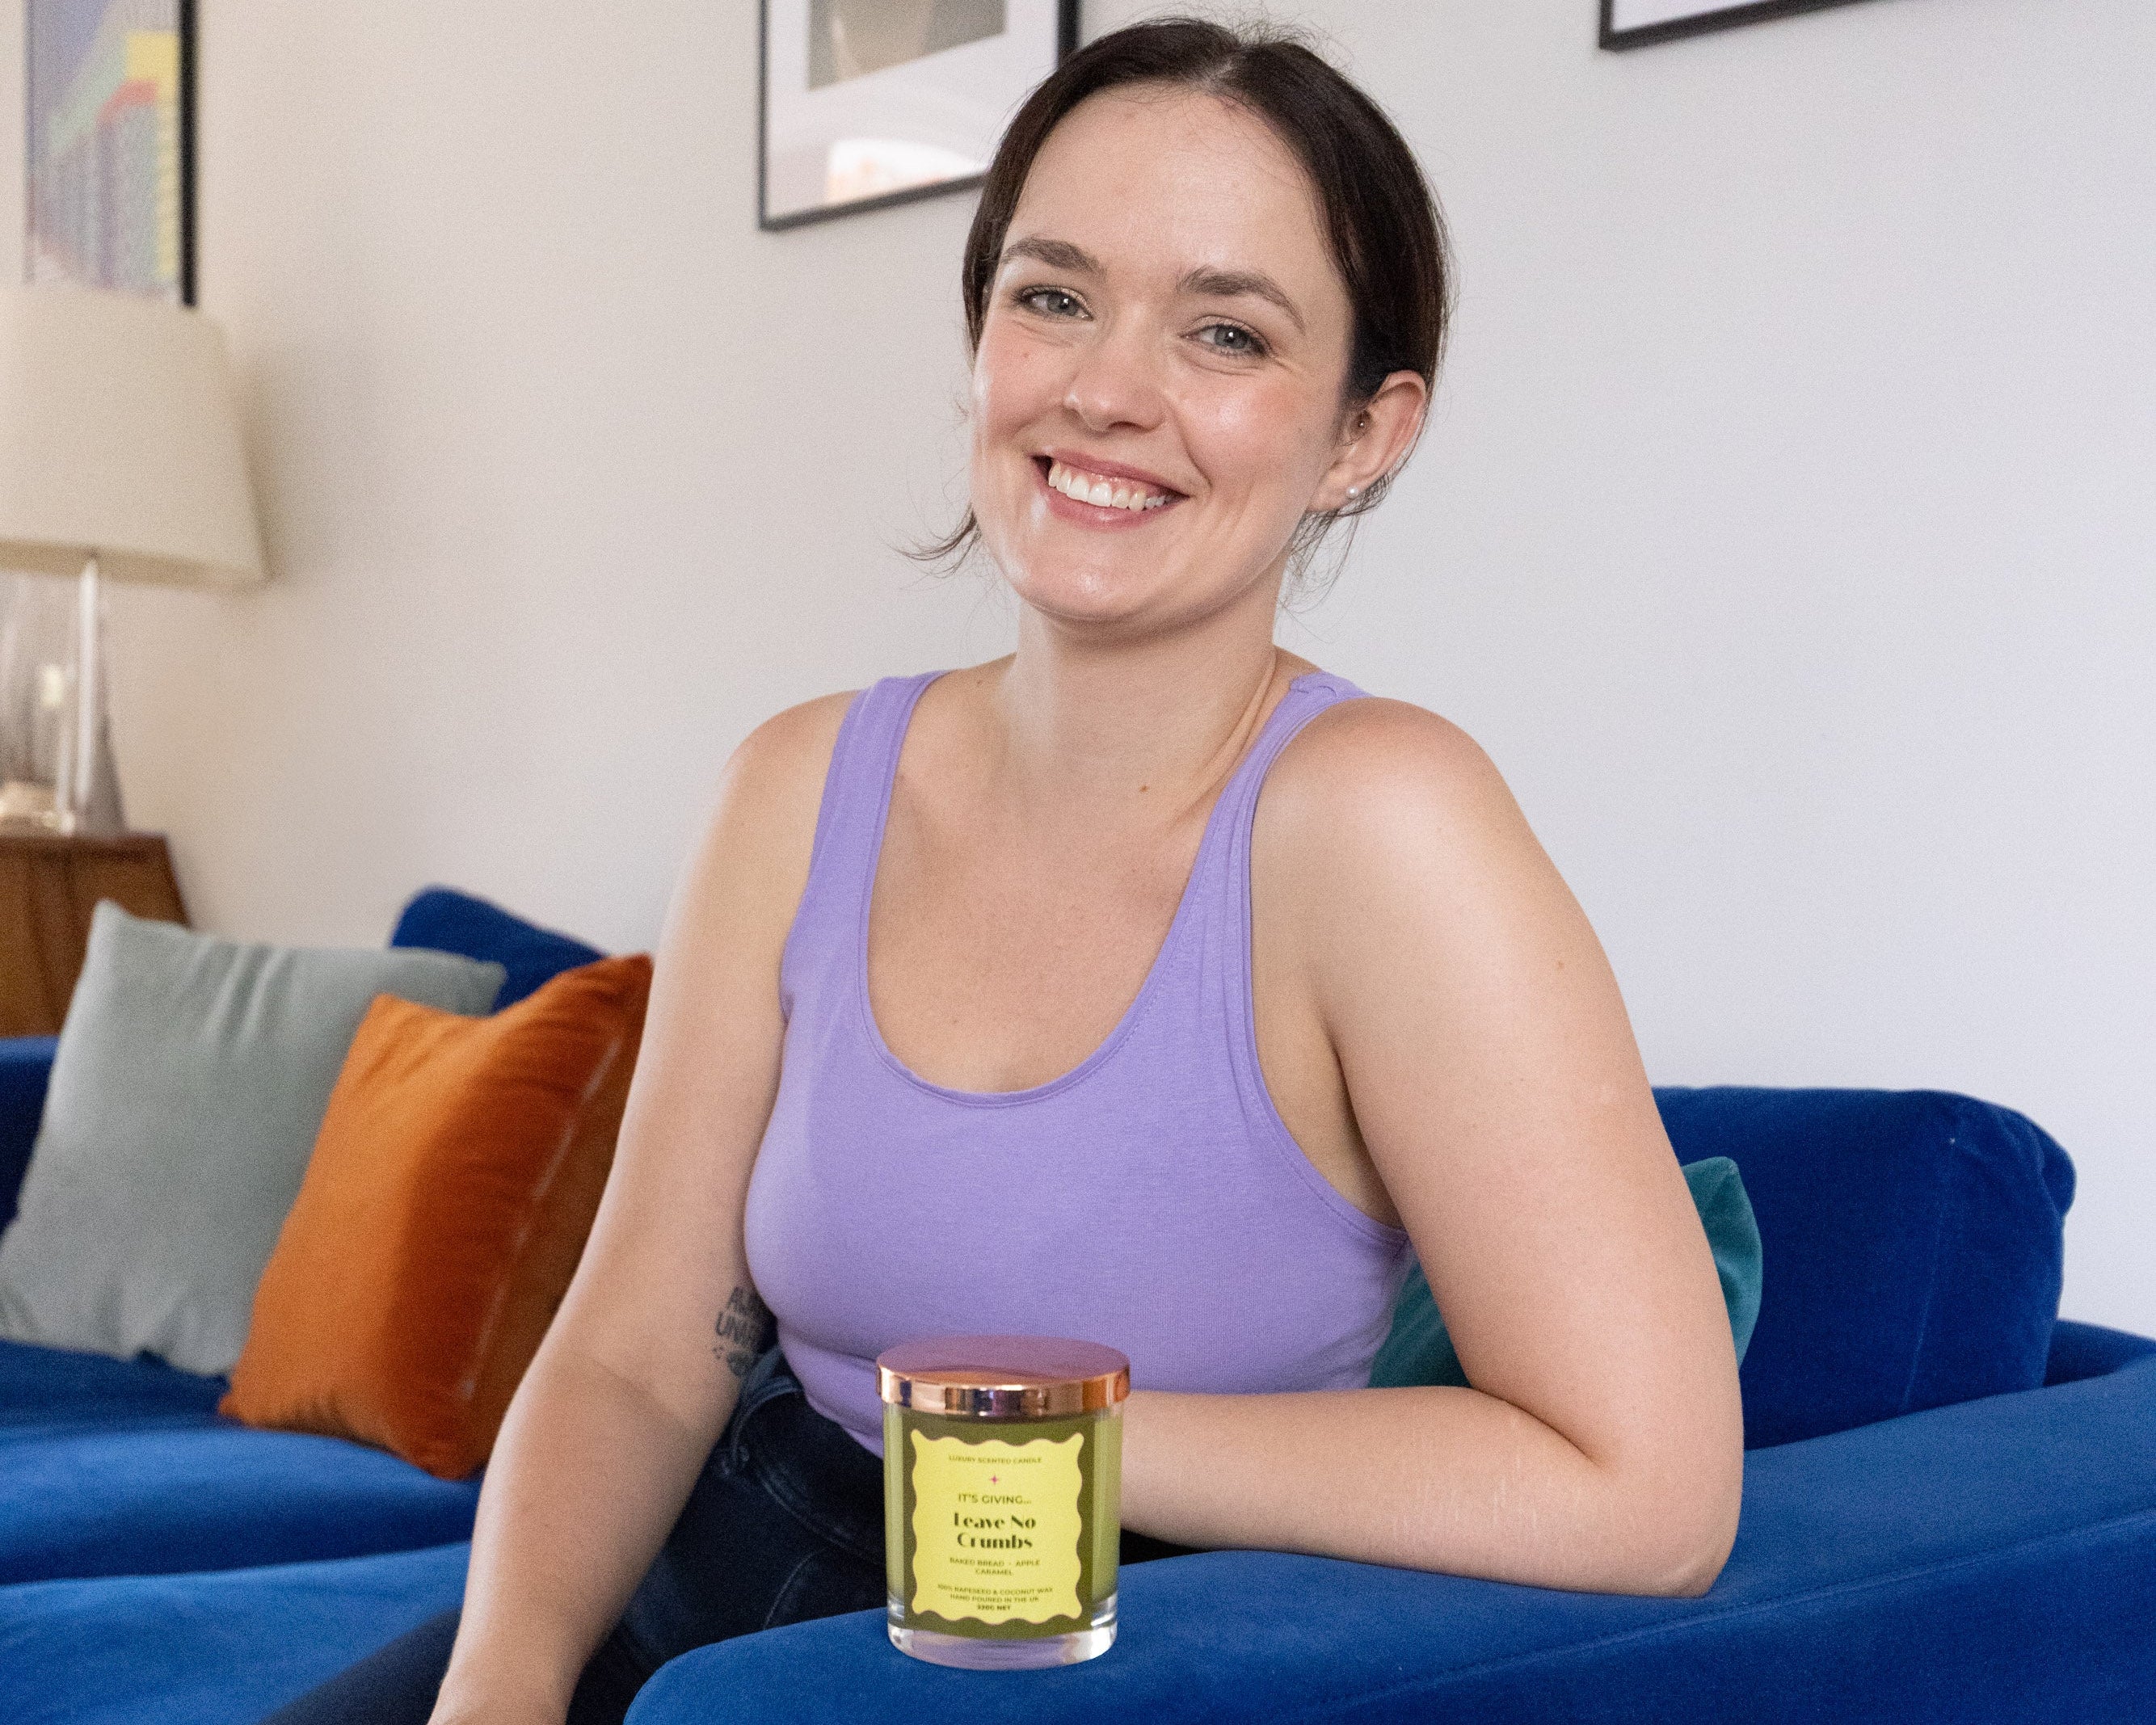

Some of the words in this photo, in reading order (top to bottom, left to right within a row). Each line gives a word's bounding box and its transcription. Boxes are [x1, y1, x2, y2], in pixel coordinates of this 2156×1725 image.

[949, 1455, 975, 1463] LUXURY
[958, 1493, 978, 1504] IT'S
[982, 1495, 1032, 1504] GIVING...
[954, 1513, 1005, 1529] Leave
[1011, 1514, 1037, 1529] No
[957, 1533, 1033, 1549] Crumbs
[950, 1557, 975, 1566] BAKED
[954, 1586, 991, 1595] RAPESEED
[950, 1593, 971, 1601] HAND
